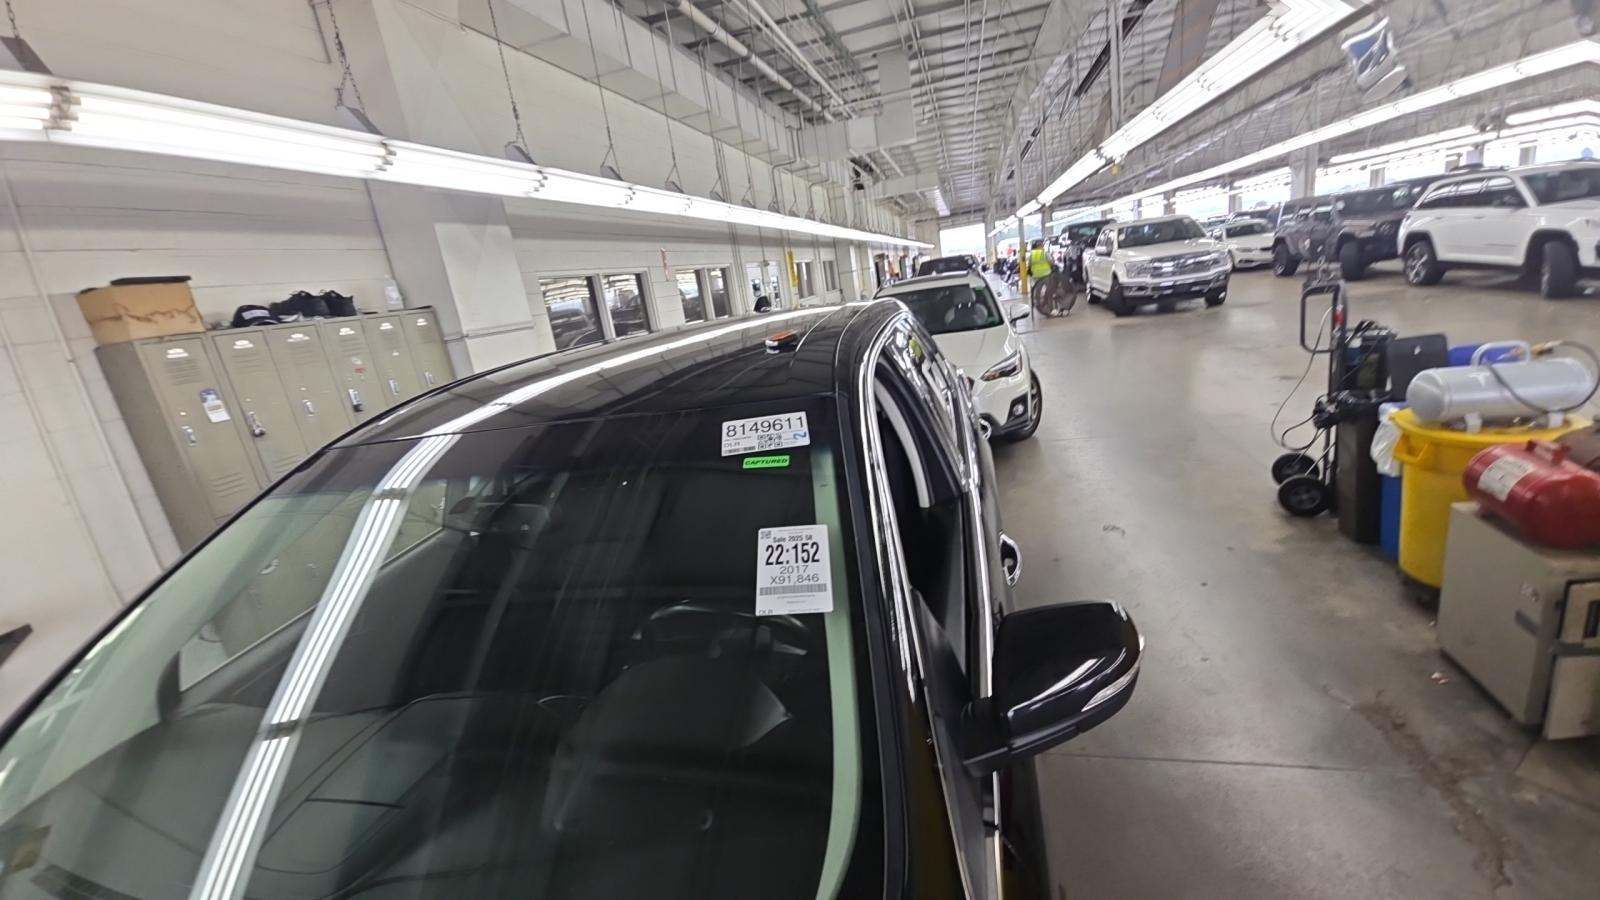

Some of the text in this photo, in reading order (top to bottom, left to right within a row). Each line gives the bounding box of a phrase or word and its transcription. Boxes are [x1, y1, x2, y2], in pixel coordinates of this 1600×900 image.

[726, 416, 804, 437] 8149611
[745, 457, 788, 466] CAPTURED
[765, 541, 820, 566] 22:152
[779, 564, 809, 575] 2017
